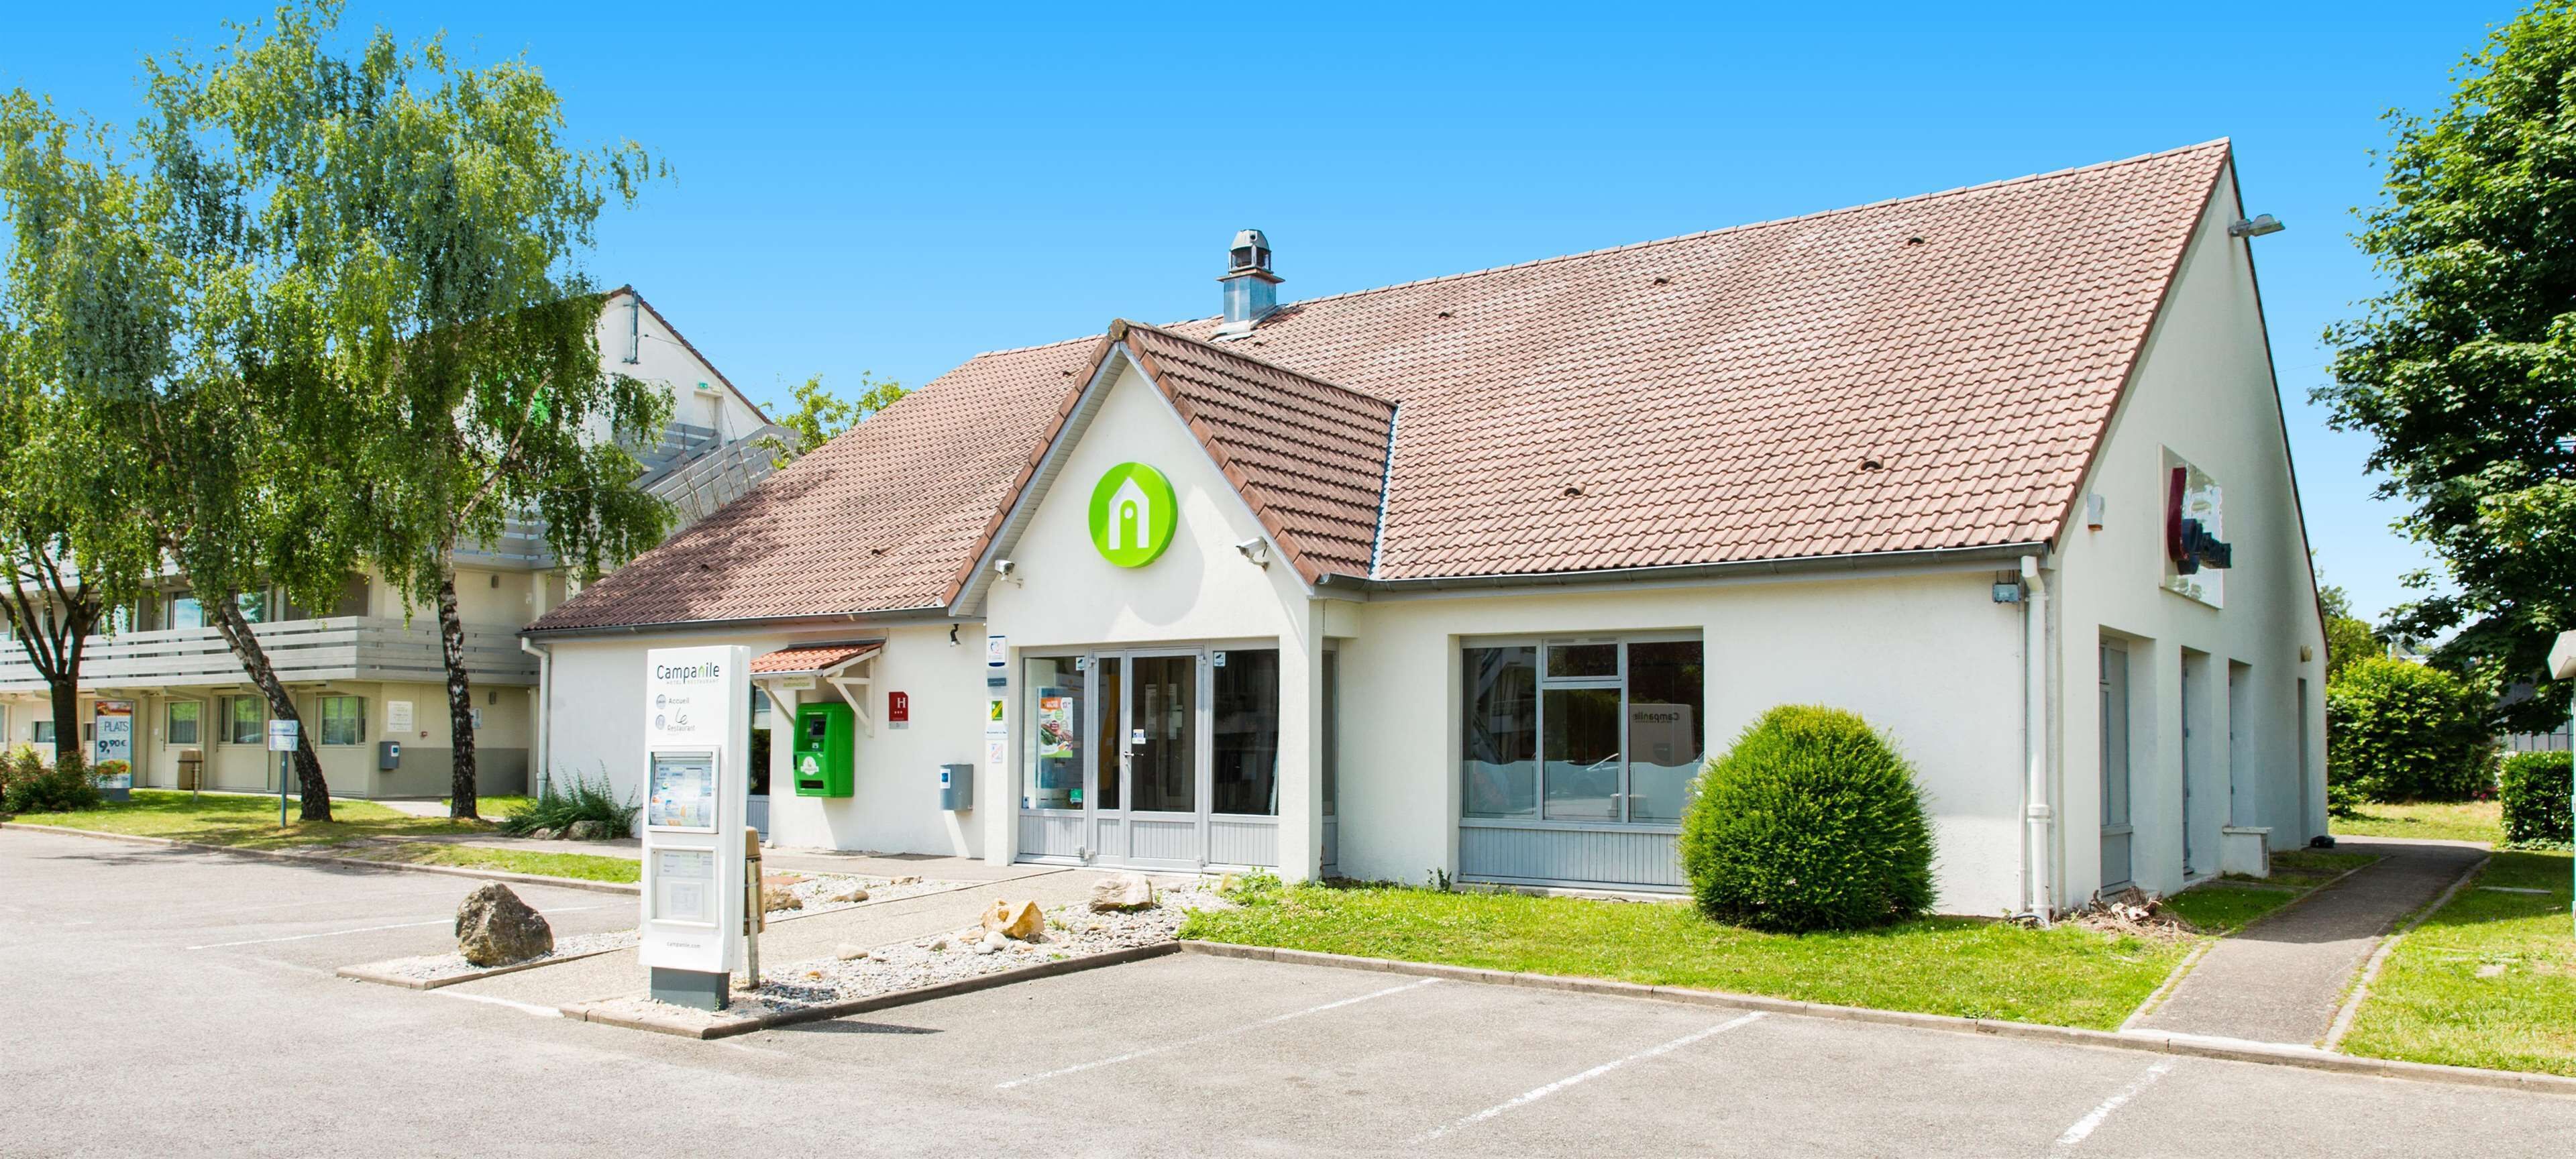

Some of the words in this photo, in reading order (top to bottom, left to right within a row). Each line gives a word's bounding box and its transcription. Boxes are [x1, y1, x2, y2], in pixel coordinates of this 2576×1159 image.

[657, 662, 720, 684] Campanile
[897, 698, 906, 708] H
[104, 721, 129, 732] PLATS
